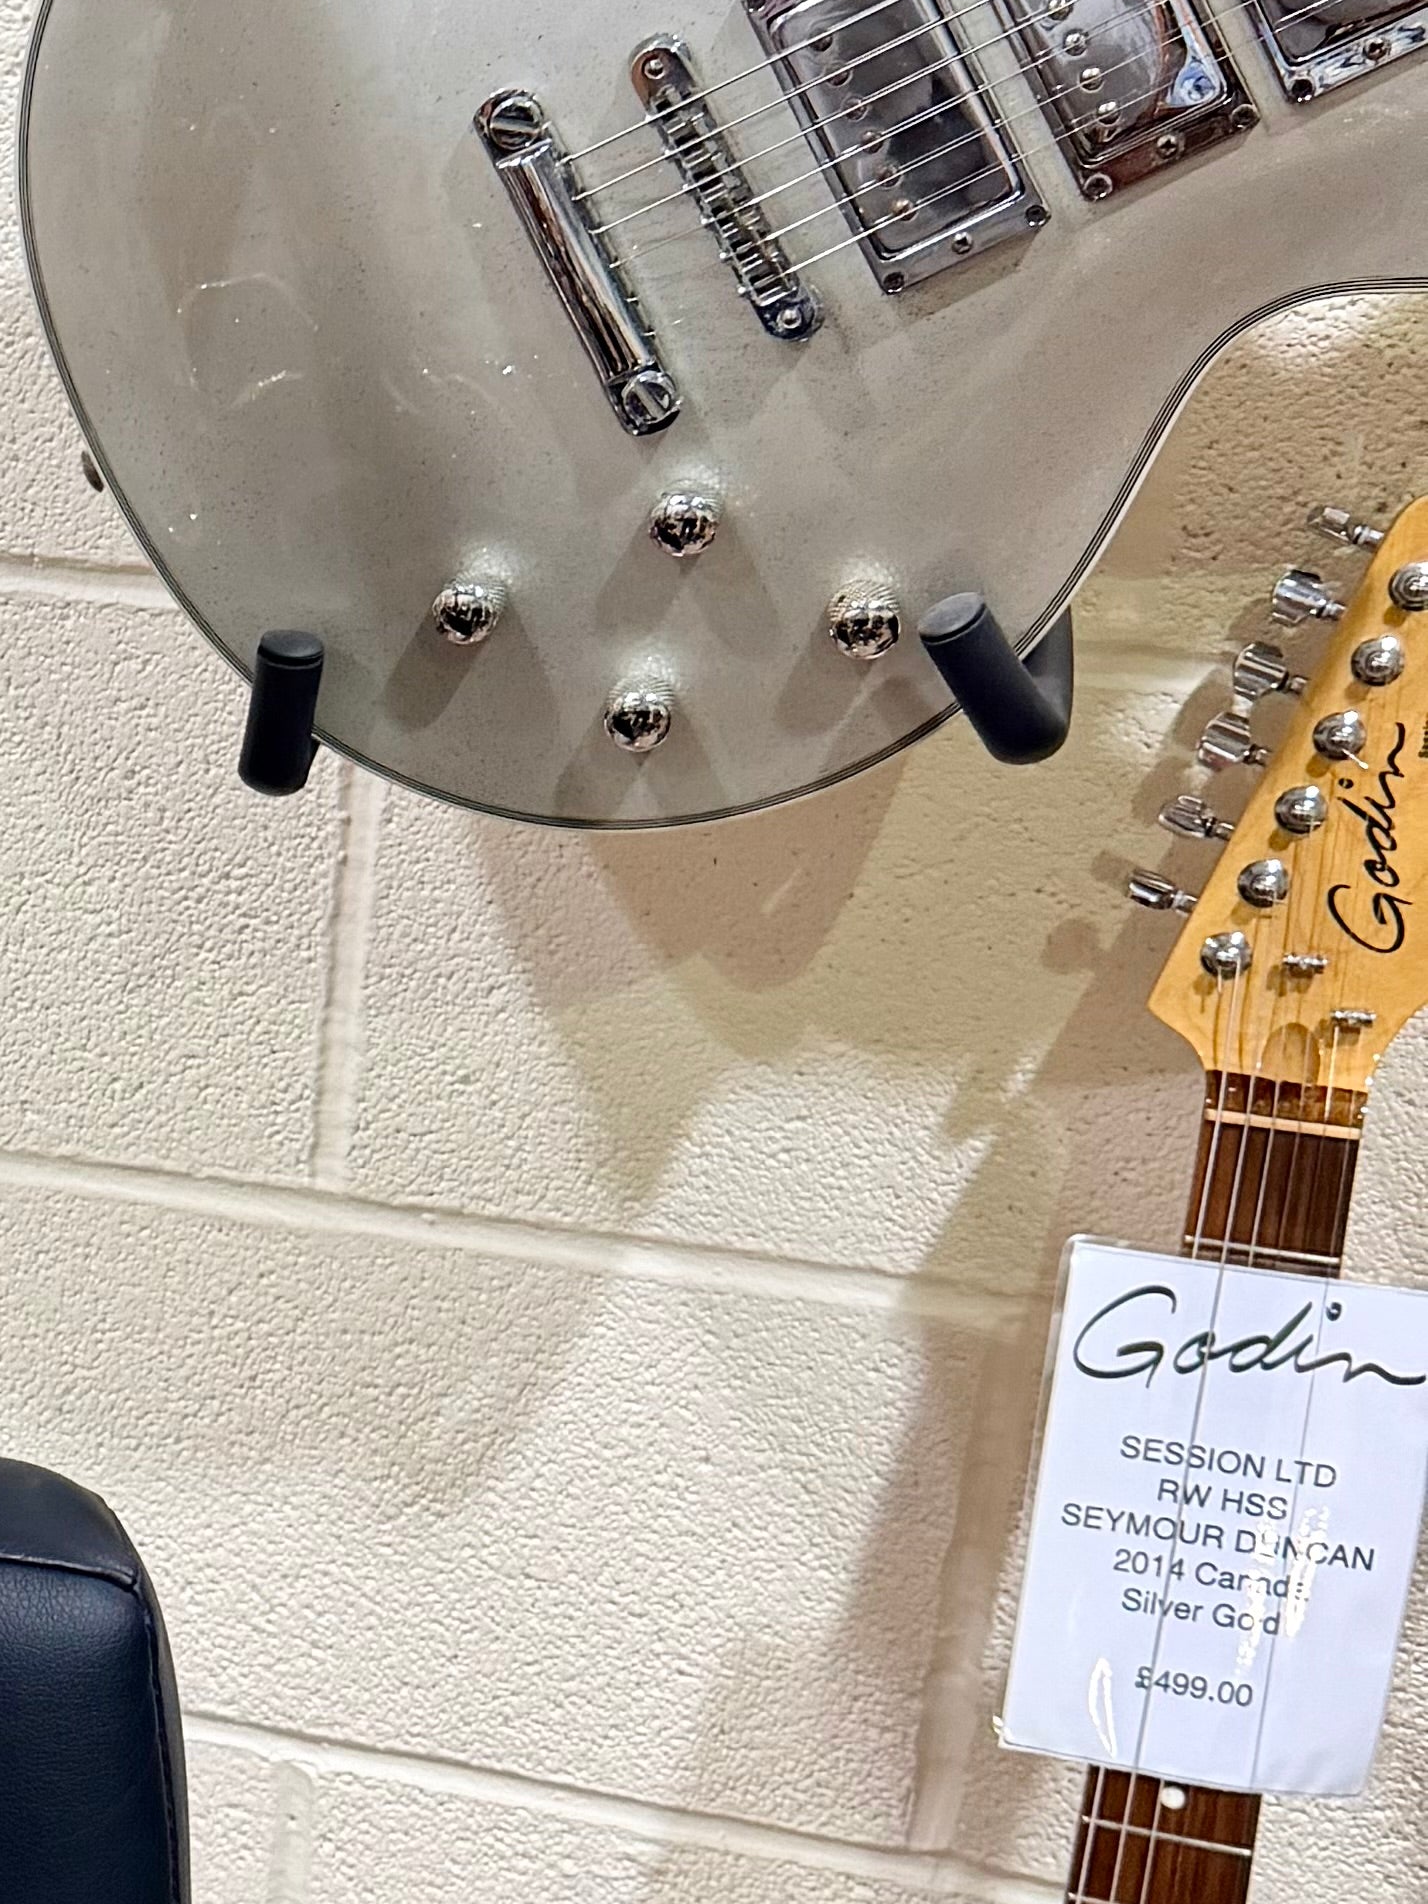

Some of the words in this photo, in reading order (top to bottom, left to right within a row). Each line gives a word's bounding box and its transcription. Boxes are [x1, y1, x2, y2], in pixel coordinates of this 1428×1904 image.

[1328, 722, 1413, 953] Godin
[1073, 1284, 1427, 1389] Godin
[1119, 1434, 1266, 1479] SESSION
[1275, 1458, 1338, 1489] LTD
[1157, 1478, 1212, 1508] RW
[1221, 1489, 1289, 1520] HSS
[1060, 1502, 1224, 1549] SEYMOUR
[1113, 1548, 1185, 1581] 2014
[1121, 1587, 1204, 1623] Silver
[1211, 1602, 1281, 1636] God
[1134, 1665, 1254, 1707] £499.00
